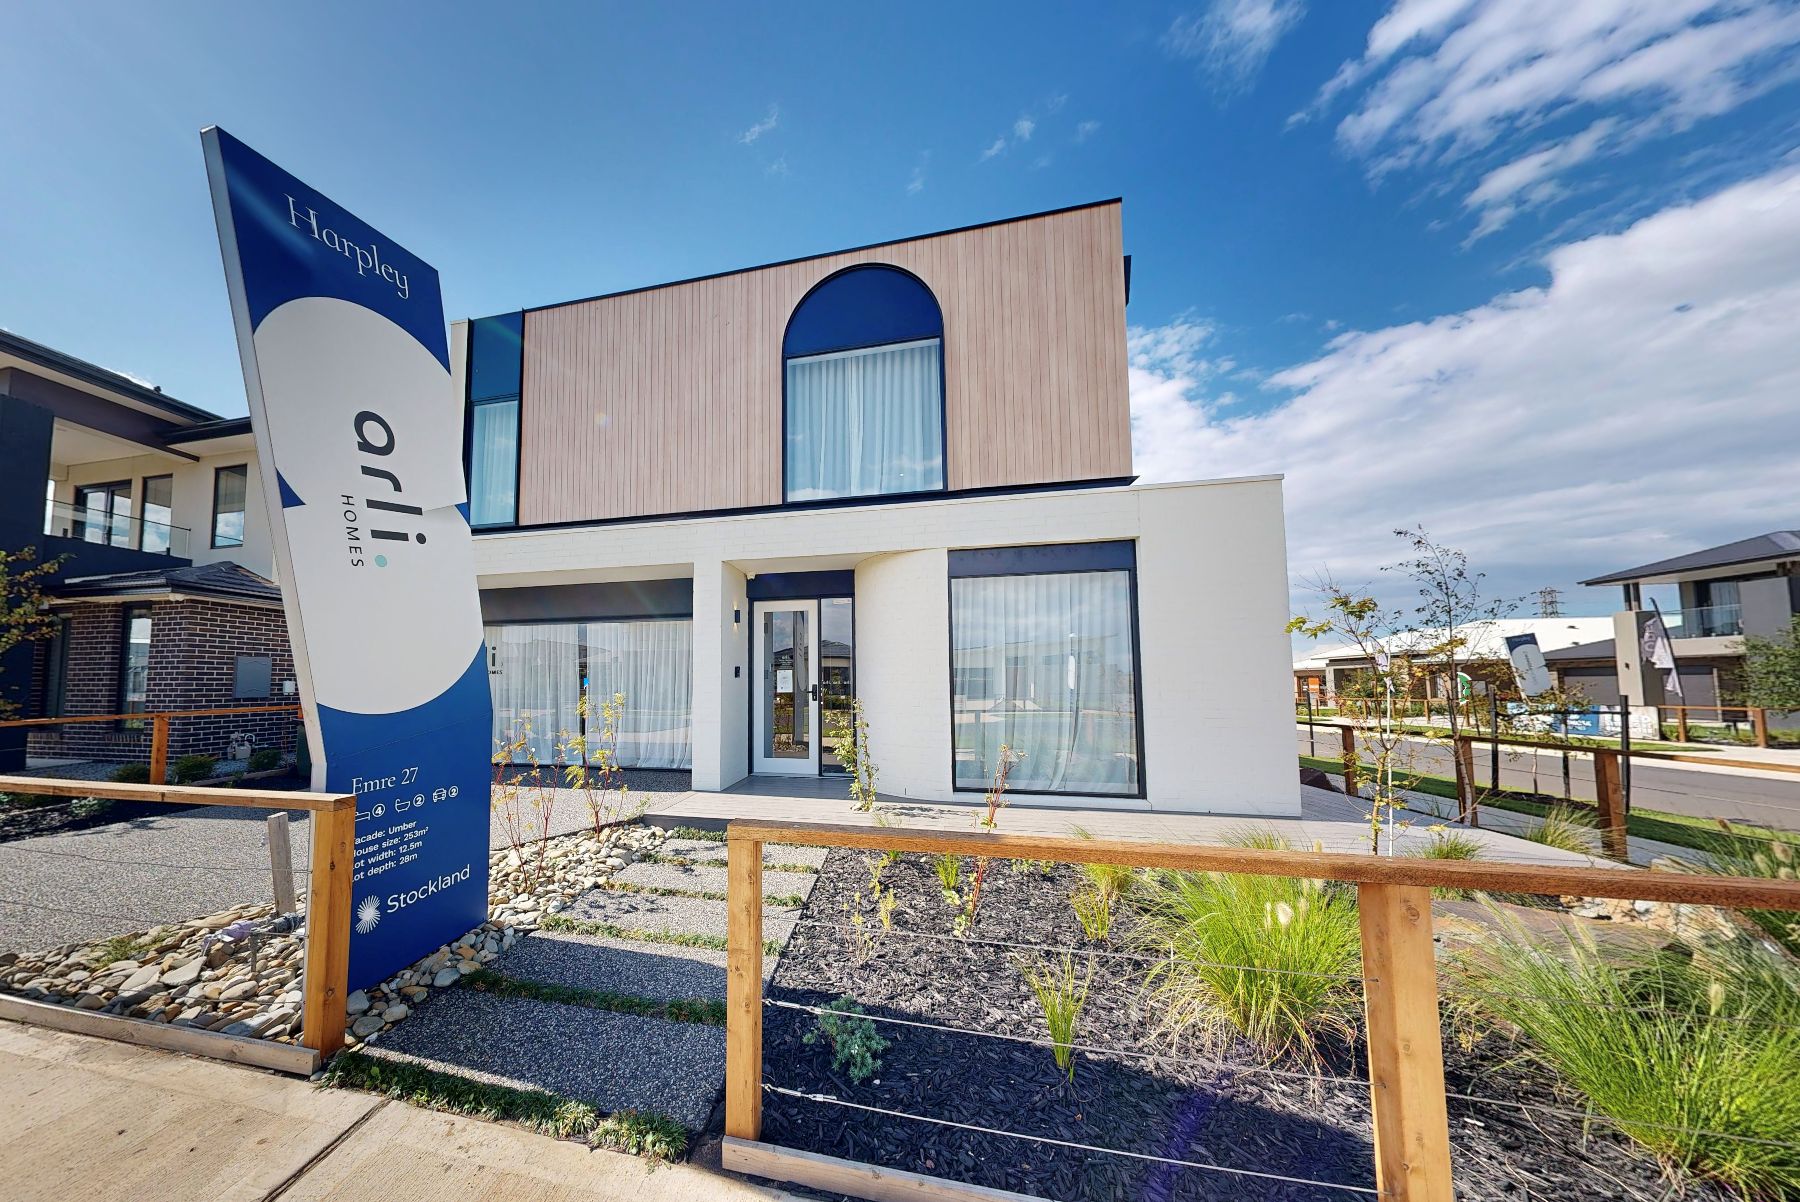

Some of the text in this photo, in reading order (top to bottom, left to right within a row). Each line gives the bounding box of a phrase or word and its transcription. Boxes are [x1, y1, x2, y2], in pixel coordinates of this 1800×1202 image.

[283, 192, 410, 300] Harpley
[353, 409, 427, 546] arli
[340, 494, 365, 568] HOMES
[352, 767, 419, 795] Emre 27
[354, 821, 417, 845] acade: Umber
[382, 837, 401, 848] size:
[352, 841, 423, 870] ot width: 12.5m
[352, 853, 418, 882] ot depth: 28m
[386, 864, 471, 914] Stockland
